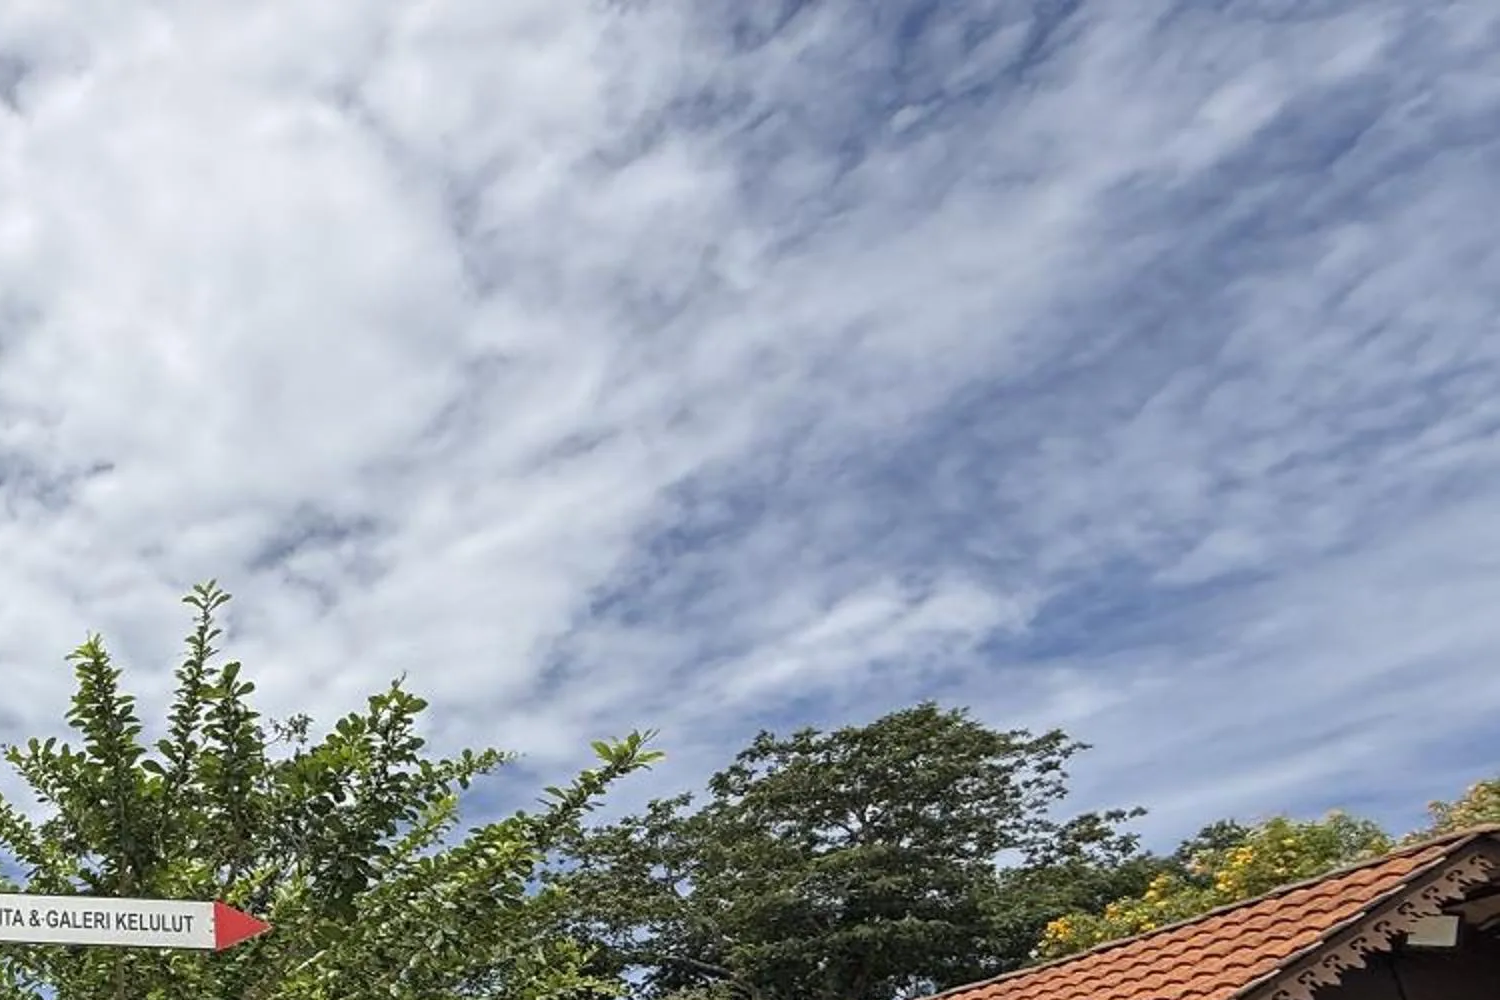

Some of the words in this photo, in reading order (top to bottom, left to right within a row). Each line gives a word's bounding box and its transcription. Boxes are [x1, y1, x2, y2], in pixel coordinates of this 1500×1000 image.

[29, 909, 41, 927] &
[46, 909, 111, 930] GALERI
[115, 912, 194, 933] KELULUT
